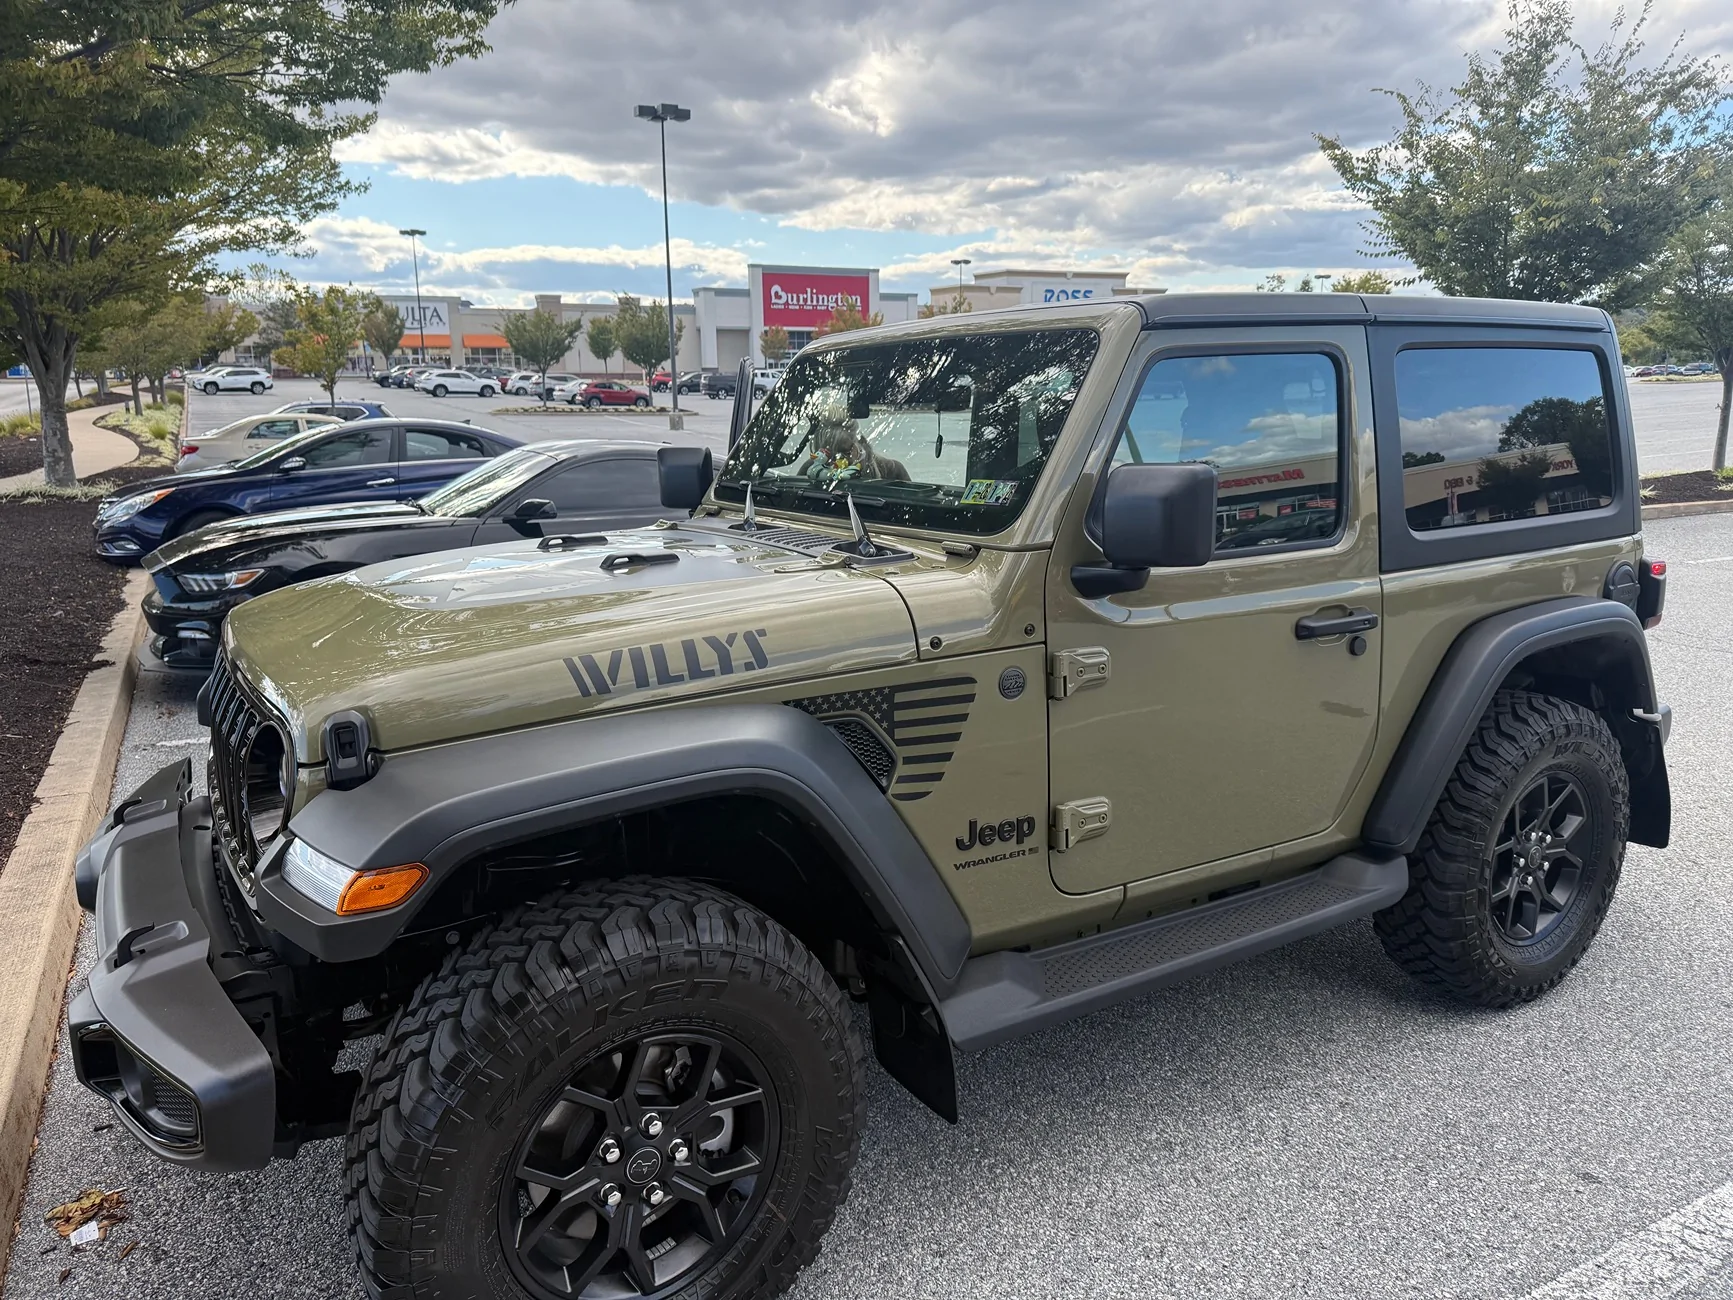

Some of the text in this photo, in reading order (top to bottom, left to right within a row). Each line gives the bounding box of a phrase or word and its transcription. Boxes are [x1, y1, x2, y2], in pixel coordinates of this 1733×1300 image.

[770, 284, 862, 311] Burlington
[562, 628, 769, 698] WILLYS
[955, 814, 1036, 852] Jeep
[953, 849, 1027, 871] WRANGLER
[484, 978, 730, 1131] FALKEN
